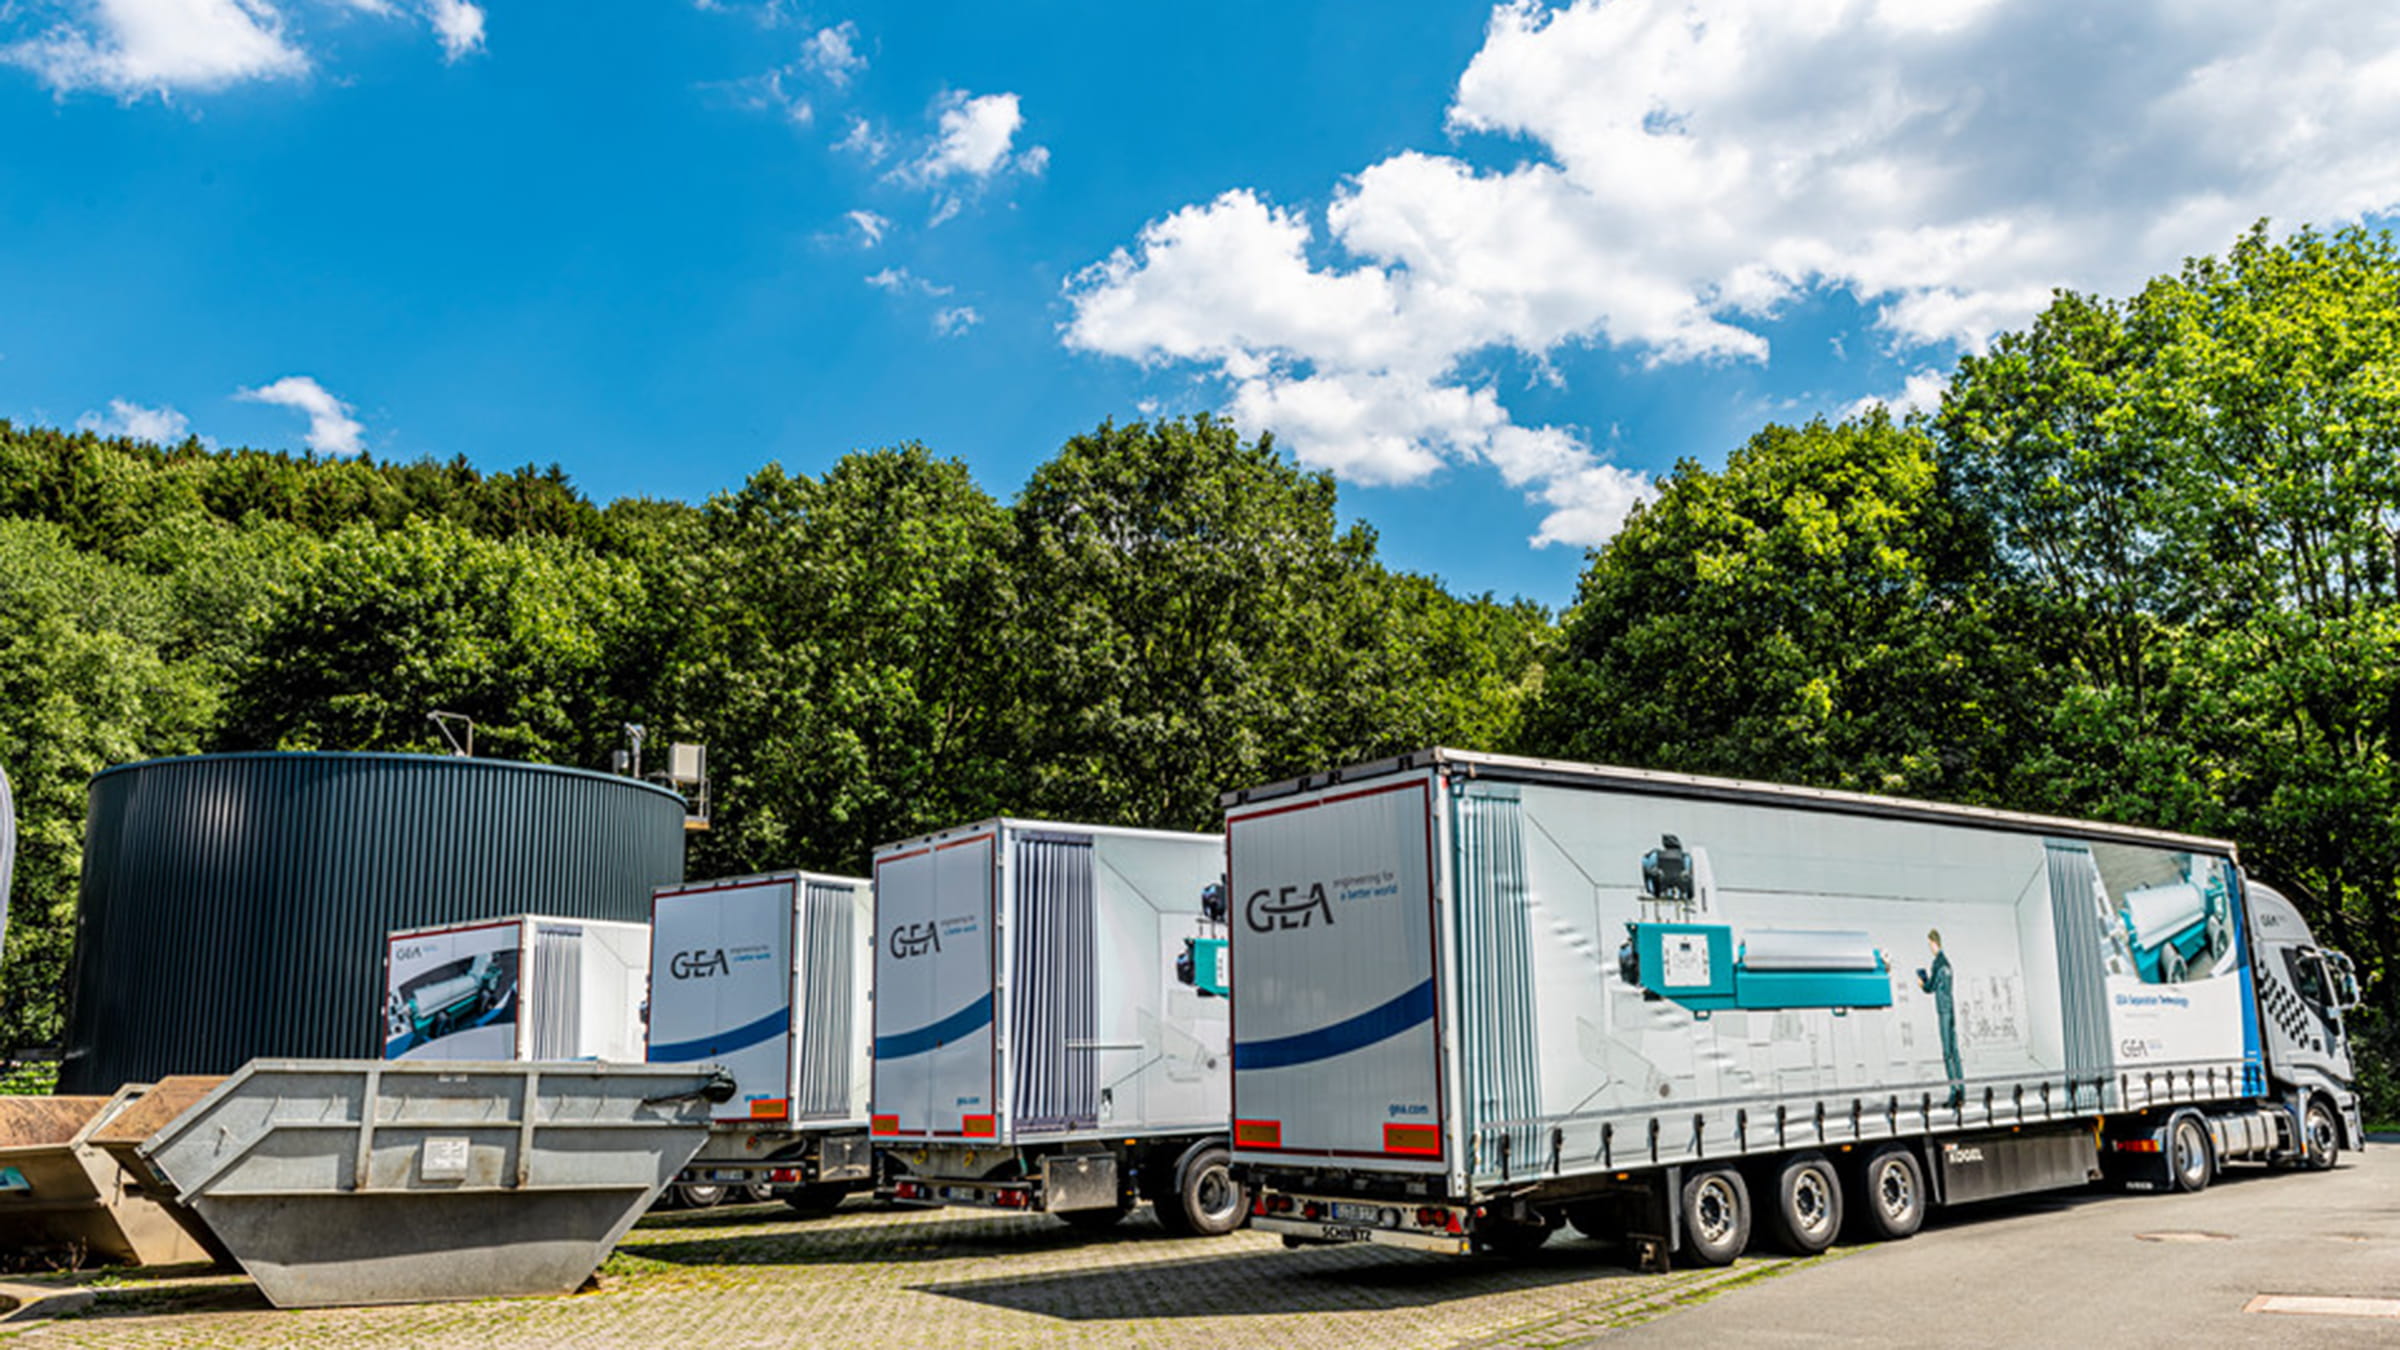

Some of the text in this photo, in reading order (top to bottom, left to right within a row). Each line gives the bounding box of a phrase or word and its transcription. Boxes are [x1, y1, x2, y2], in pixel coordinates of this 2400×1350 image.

[1246, 883, 1334, 933] GEA
[890, 921, 941, 960] GEA
[671, 948, 729, 980] GEA
[2121, 1039, 2148, 1057] GEA
